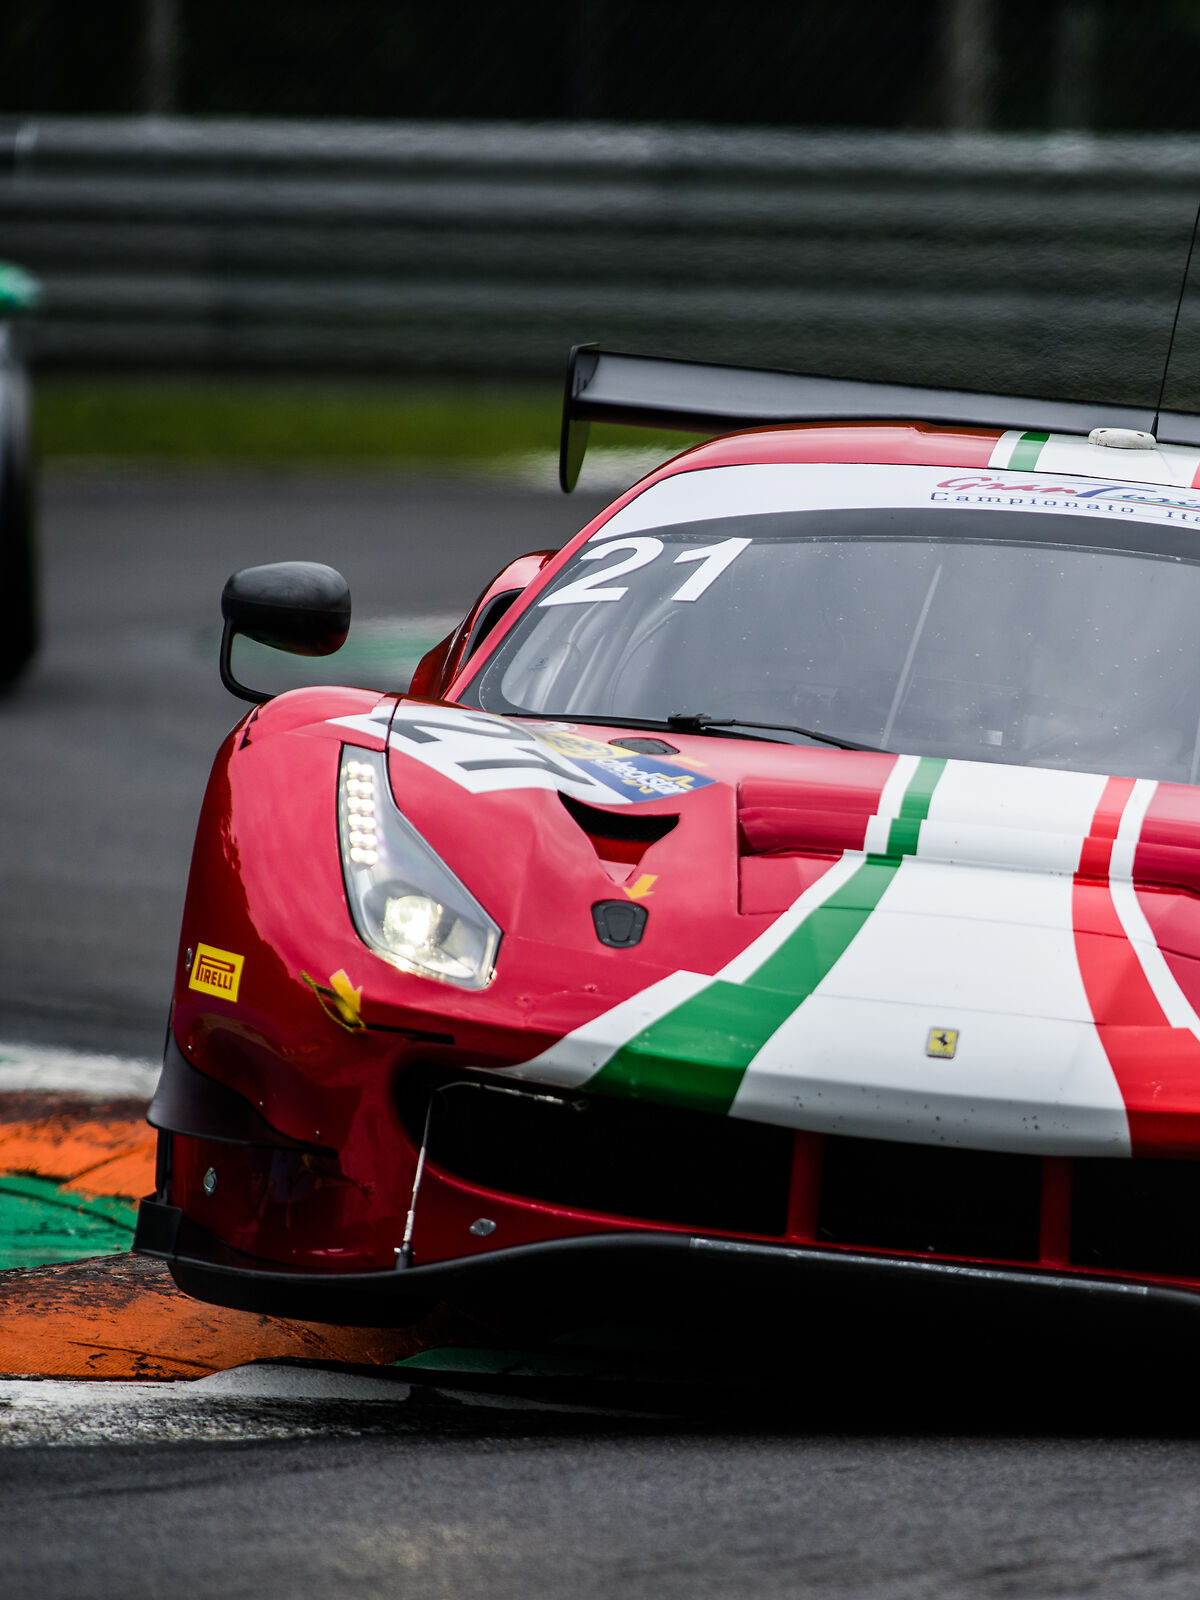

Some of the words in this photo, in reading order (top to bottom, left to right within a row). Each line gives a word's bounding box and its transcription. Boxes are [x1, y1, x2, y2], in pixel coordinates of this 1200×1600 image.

[930, 492, 1134, 513] Campionato
[538, 537, 753, 607] 21
[195, 954, 236, 990] PIRELLI
